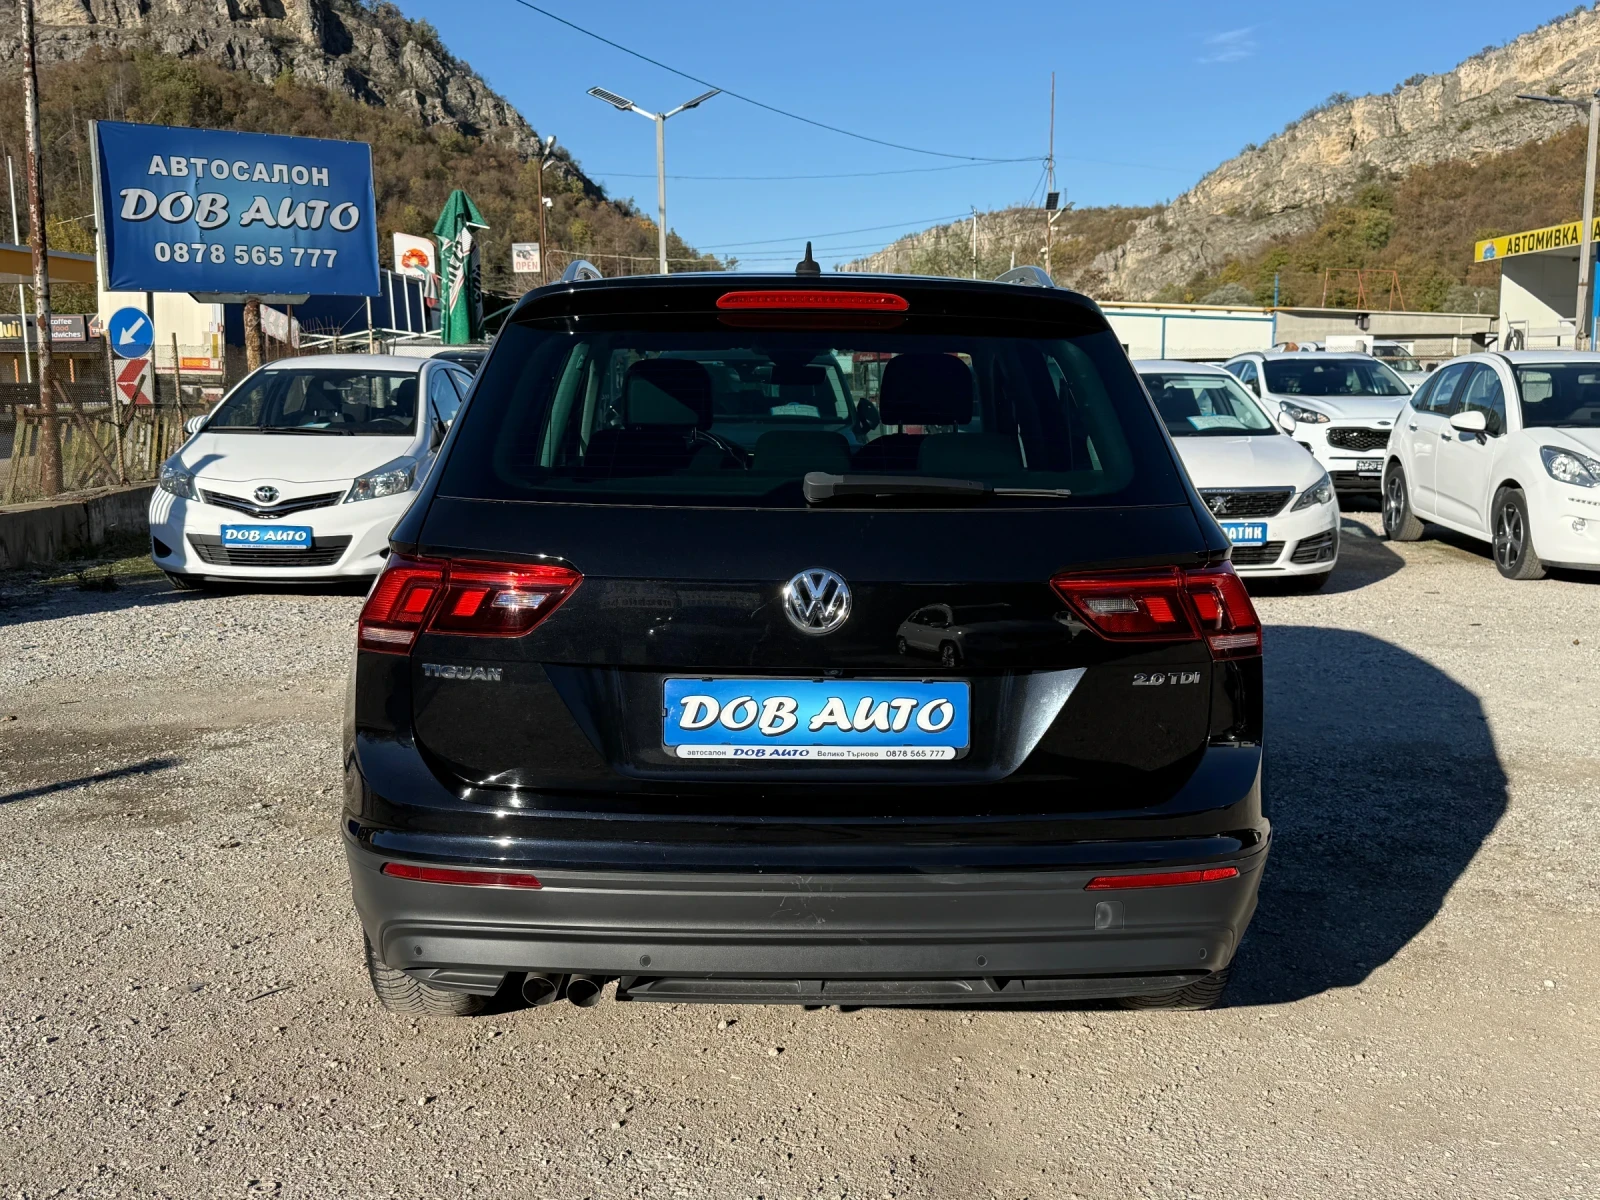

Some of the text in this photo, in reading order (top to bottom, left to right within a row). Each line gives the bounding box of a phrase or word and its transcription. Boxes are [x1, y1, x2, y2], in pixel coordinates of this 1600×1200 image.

[147, 154, 330, 187] АВТОСАЛОН
[120, 188, 360, 232] DOB AUTO
[1506, 225, 1579, 255] АВТОМИВКА
[154, 242, 338, 268] 0878 565 777
[515, 261, 539, 271] OPEN
[225, 529, 307, 542] DOB AUTO
[422, 663, 503, 681] TIGUAN
[1132, 672, 1200, 686] 2.0 TDI
[679, 695, 955, 735] DOB AUTO
[733, 748, 766, 758] DOB
[769, 749, 810, 757] AUTO
[846, 750, 879, 759] Търново
[886, 750, 908, 758] 0878
[910, 750, 927, 758] 565
[929, 750, 946, 758] 777
